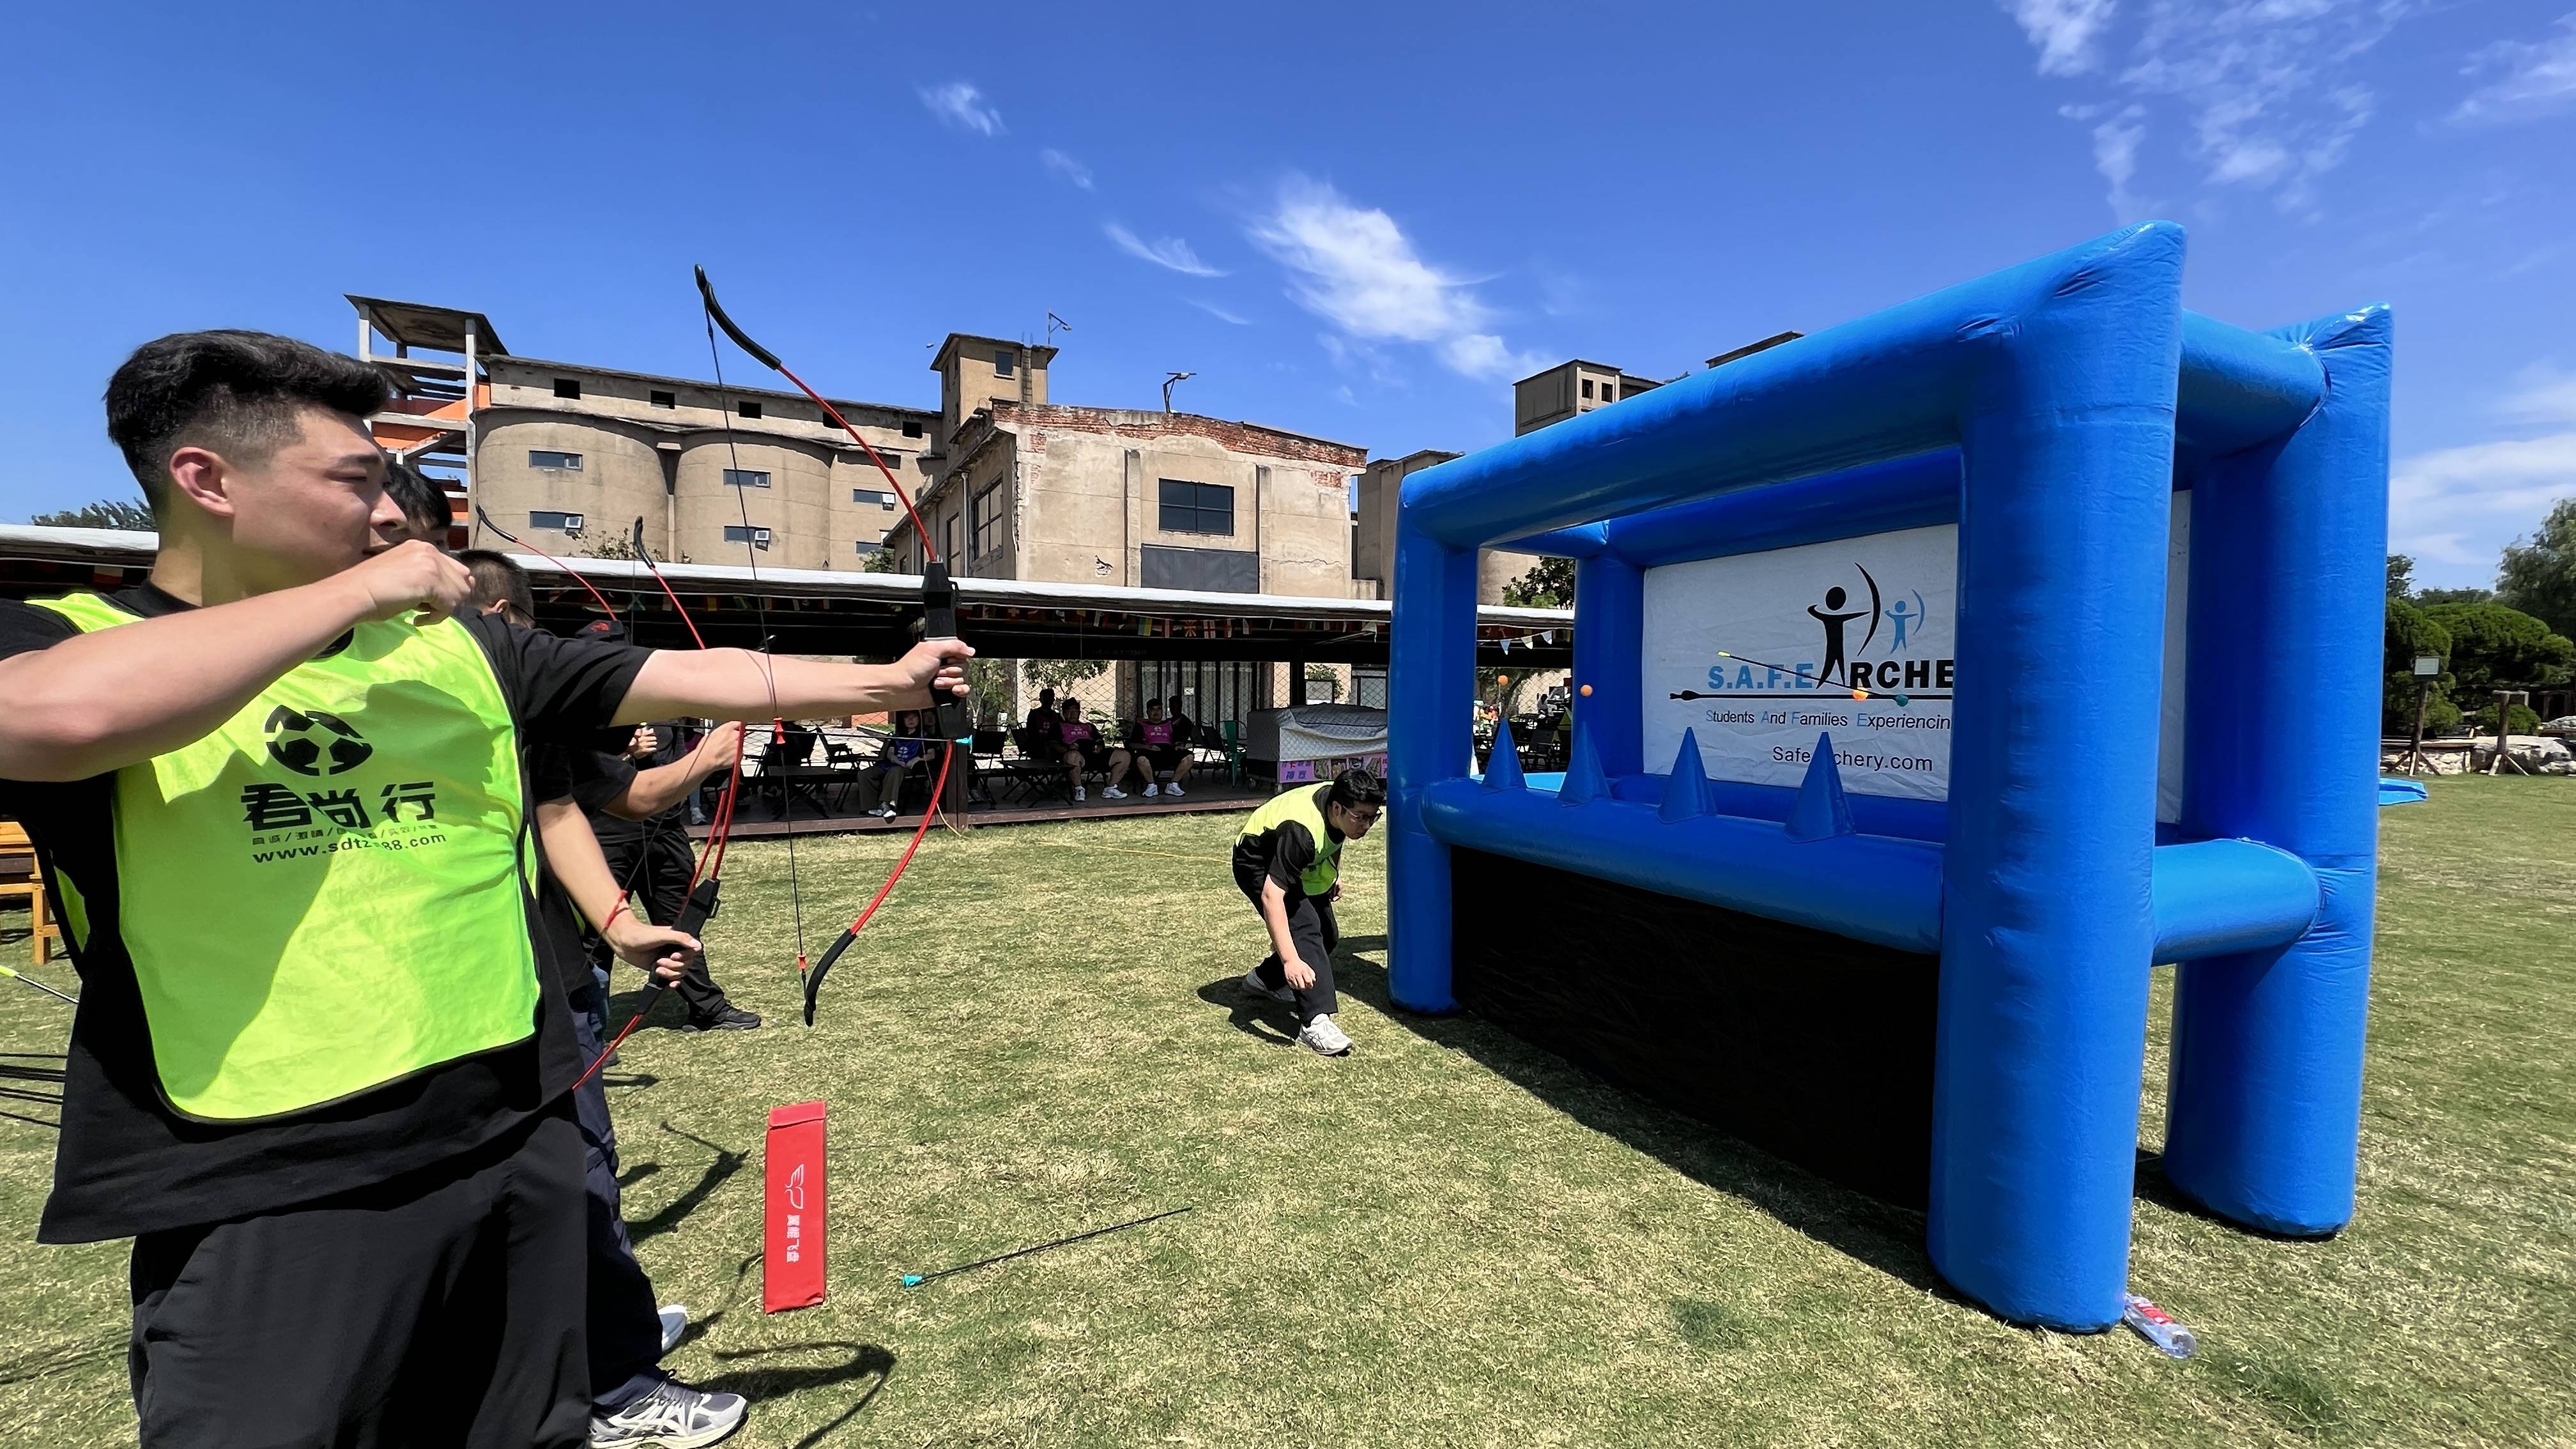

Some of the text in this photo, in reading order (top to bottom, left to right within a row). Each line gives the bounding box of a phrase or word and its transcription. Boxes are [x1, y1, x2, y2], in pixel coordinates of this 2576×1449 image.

[1705, 709, 1951, 731] Students And Families Experiencin
[1772, 746, 1933, 772] Safechery.com
